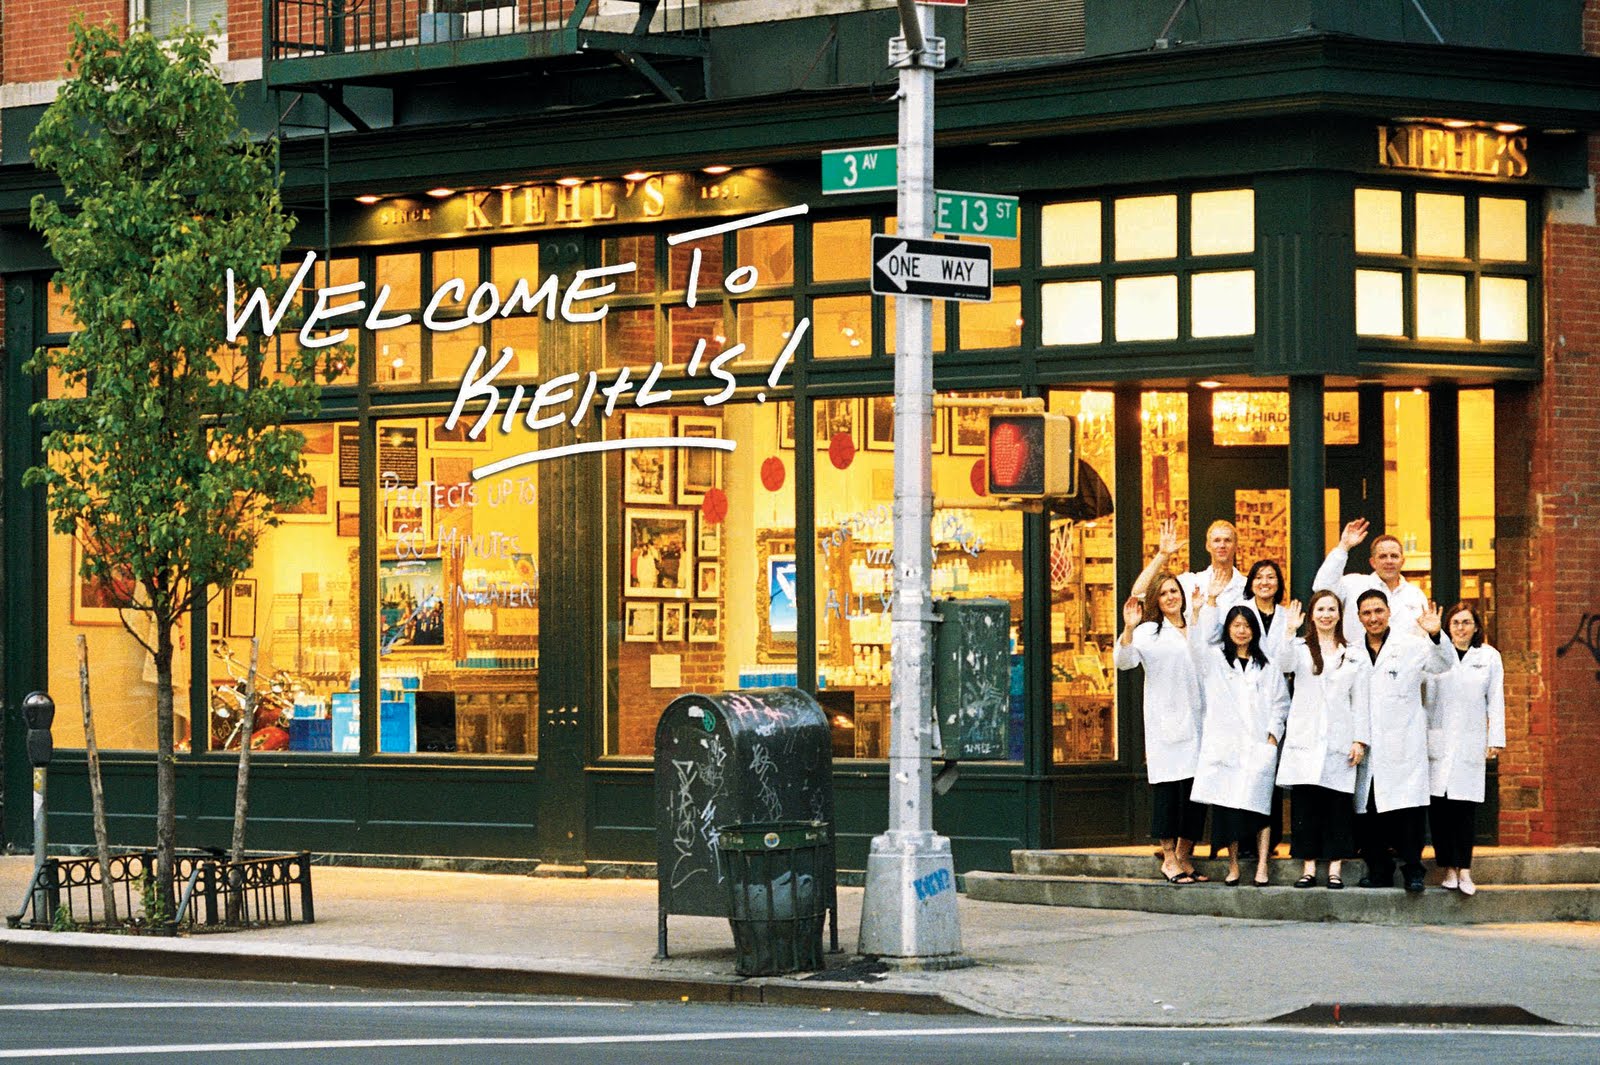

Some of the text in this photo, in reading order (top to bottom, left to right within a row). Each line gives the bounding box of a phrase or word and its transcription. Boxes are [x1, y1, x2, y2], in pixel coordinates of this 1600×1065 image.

[1377, 125, 1528, 177] KIEHL'S
[843, 153, 878, 187] 3 AV
[464, 177, 666, 231] KIEHL'S
[937, 197, 1012, 231] E 13 ST
[889, 255, 975, 282] ONE WAY
[1246, 412, 1287, 425] THIRD
